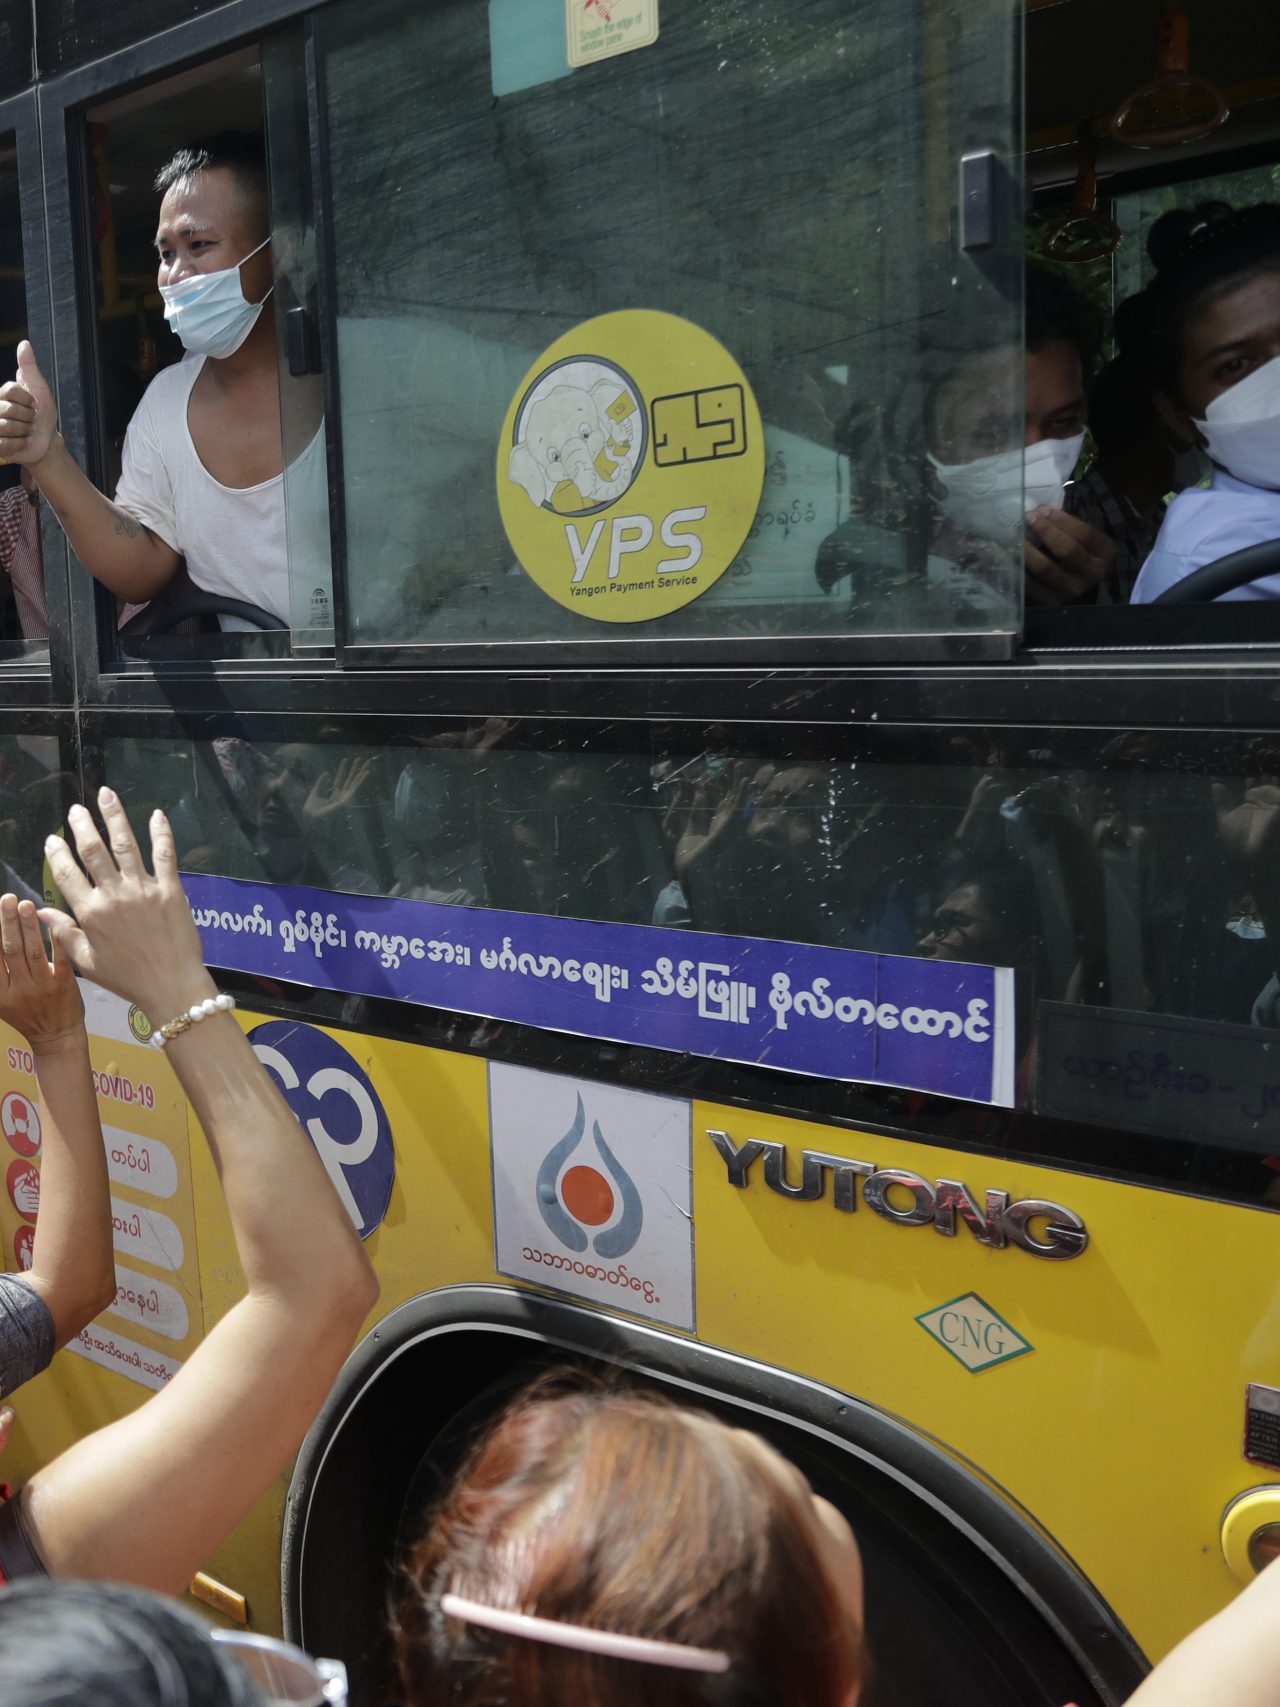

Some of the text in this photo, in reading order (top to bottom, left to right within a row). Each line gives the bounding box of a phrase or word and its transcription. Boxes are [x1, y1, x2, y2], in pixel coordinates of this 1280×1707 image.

[564, 505, 707, 583] YPS
[570, 575, 698, 597] Yangon Payment Service
[8, 1047, 154, 1109] STO COVID-19
[706, 1129, 1089, 1260] YUTONG
[939, 1311, 1005, 1356] CNG
